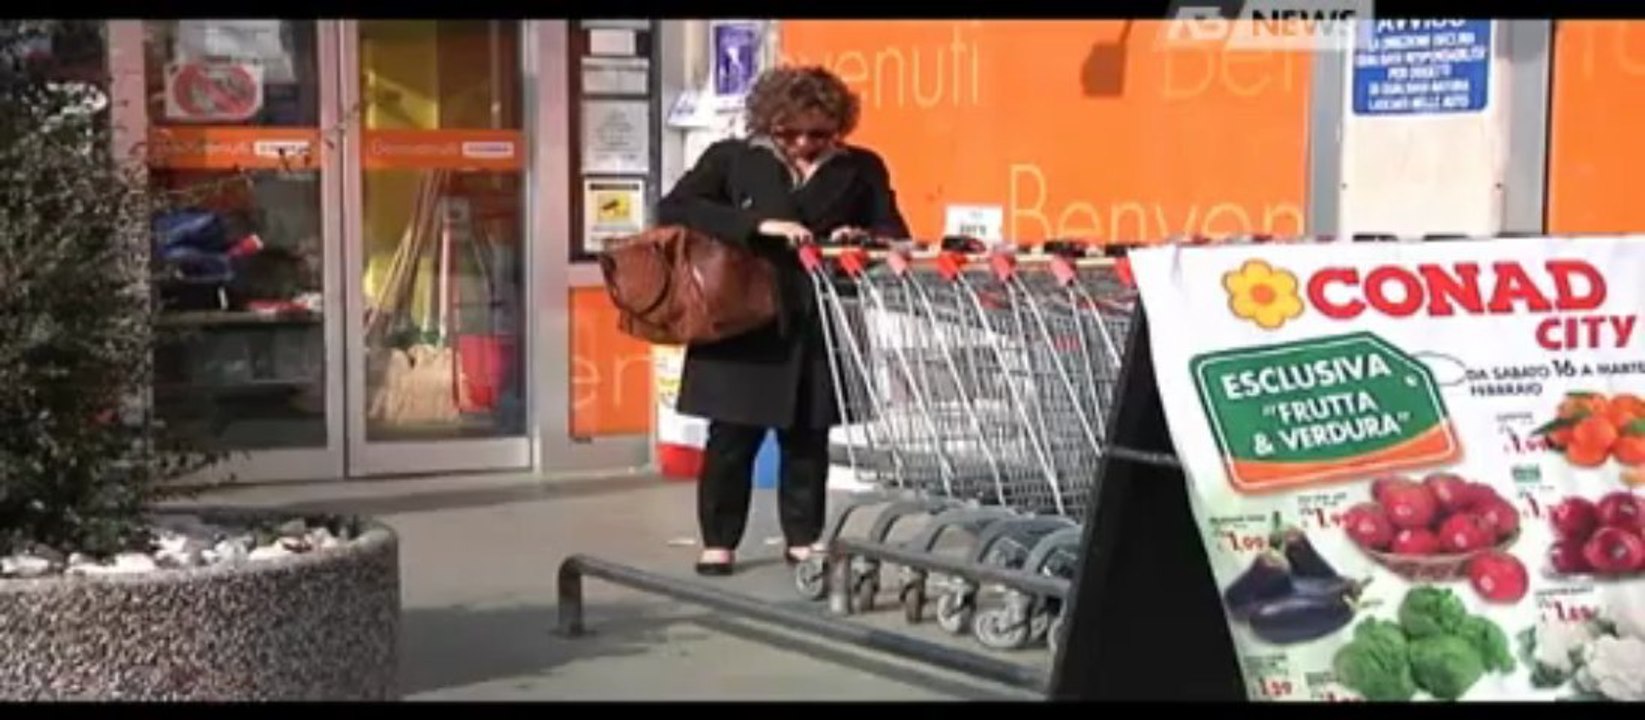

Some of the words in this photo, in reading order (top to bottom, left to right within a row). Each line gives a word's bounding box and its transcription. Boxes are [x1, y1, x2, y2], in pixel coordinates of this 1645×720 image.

[1306, 259, 1608, 320] CONAD
[1535, 314, 1637, 351] CITY
[1221, 352, 1392, 400] ESCLUSIVA
[1493, 365, 1550, 379] SABATO
[1552, 359, 1577, 377] 16
[1581, 364, 1593, 375] A
[1254, 432, 1275, 455] &
